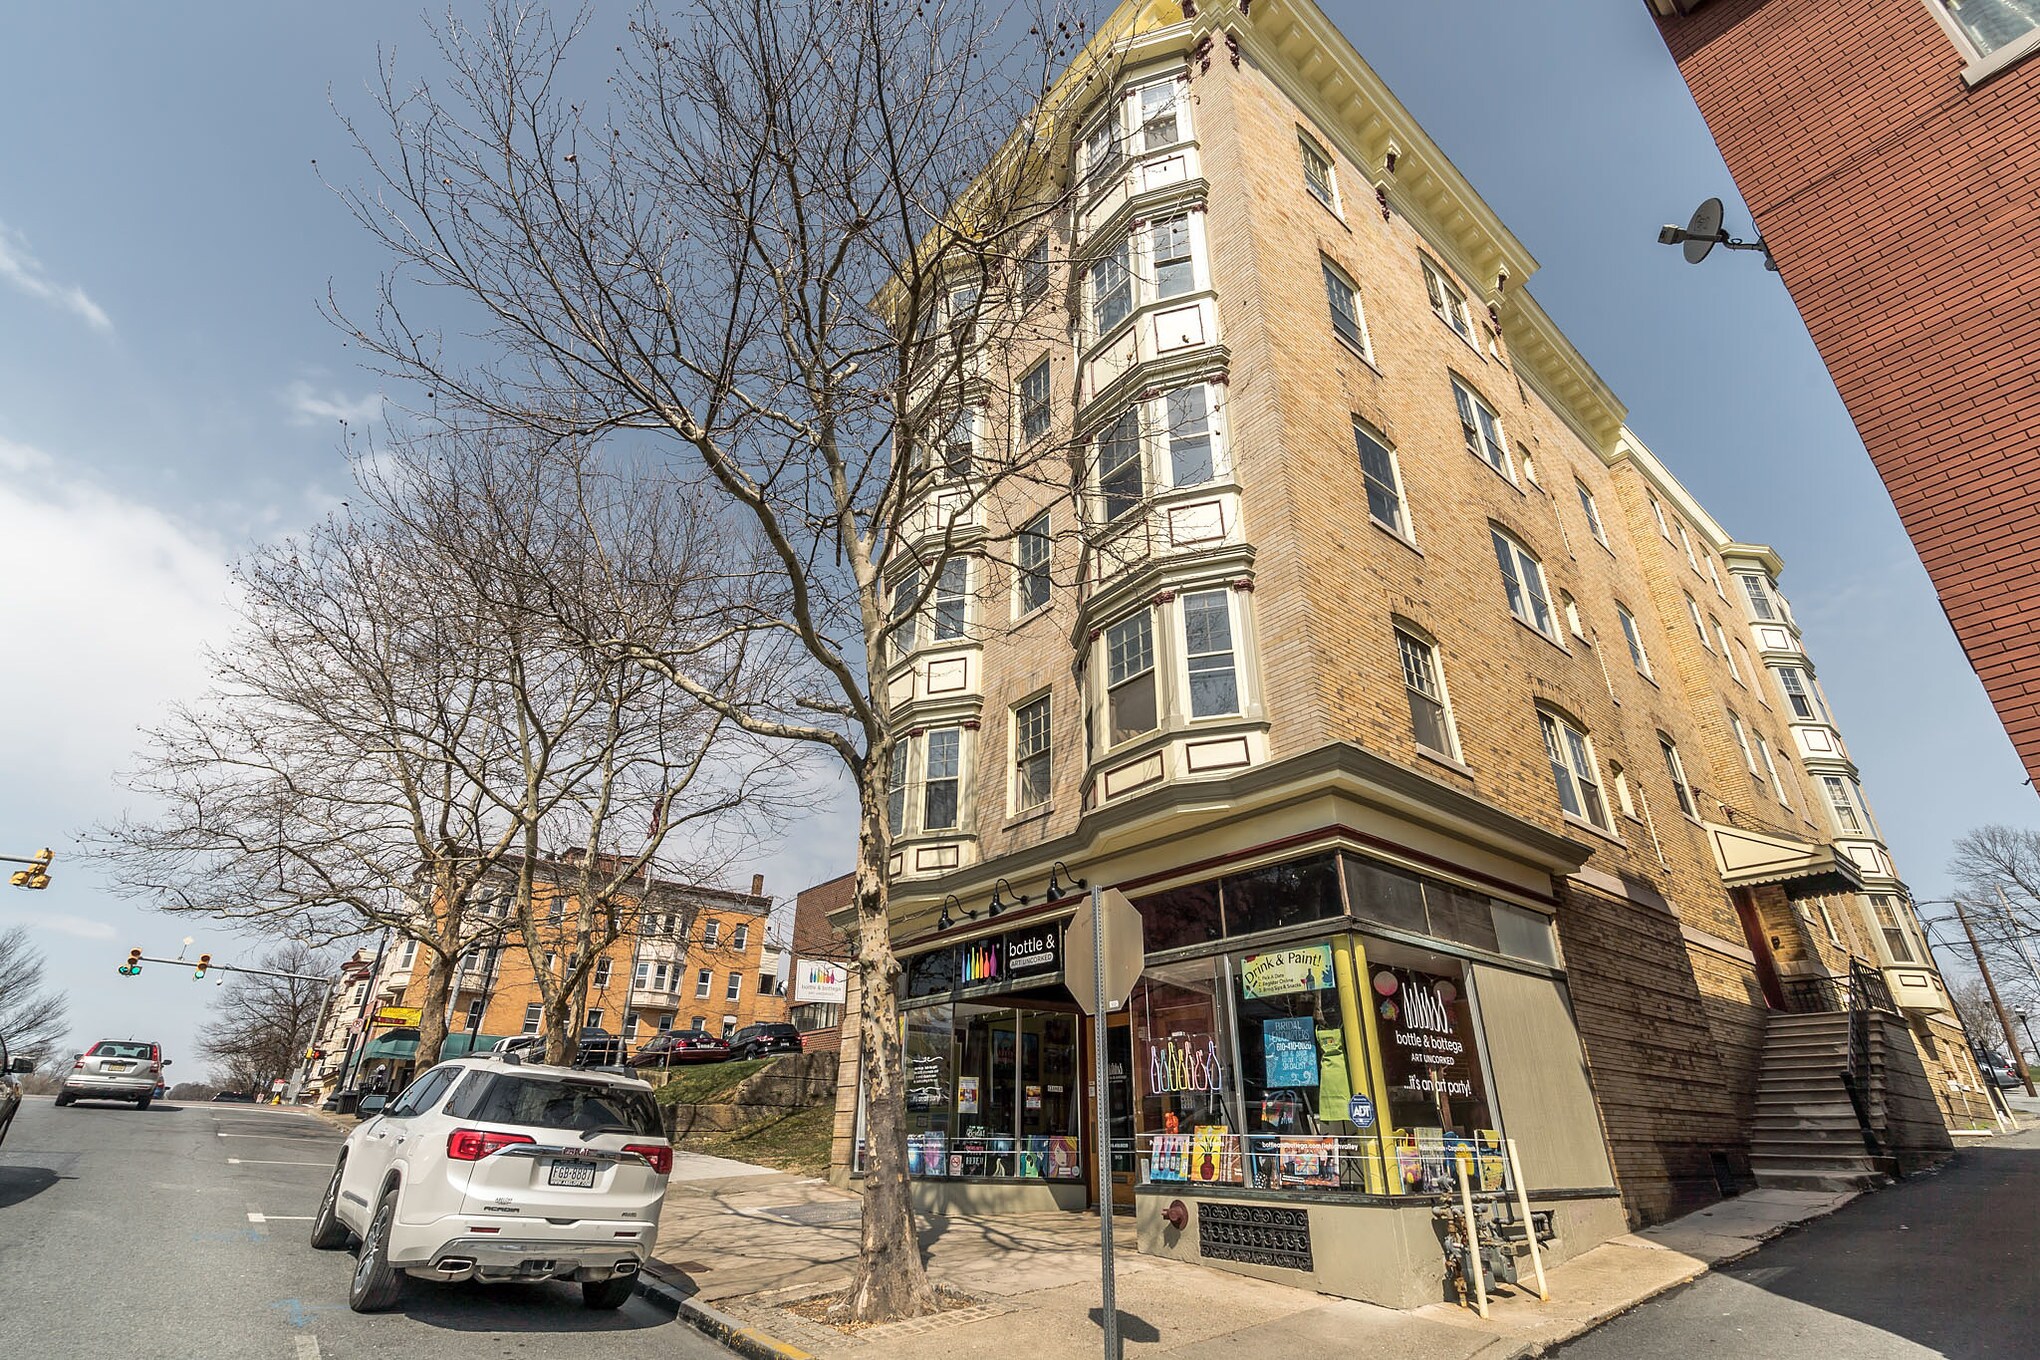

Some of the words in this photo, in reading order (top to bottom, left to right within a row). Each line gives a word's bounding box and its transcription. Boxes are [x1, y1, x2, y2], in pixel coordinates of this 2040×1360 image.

[1010, 937, 1043, 957] bottle
[1046, 934, 1055, 949] &
[1022, 954, 1052, 965] UNCORKED
[1244, 956, 1274, 984] Drink
[1275, 953, 1284, 966] &
[1288, 950, 1322, 967] Paint!
[1275, 1020, 1301, 1030] BRIDAL
[1395, 1030, 1422, 1047] bottle
[1423, 1034, 1430, 1048] &
[1430, 1034, 1463, 1054] bottega
[1411, 1053, 1422, 1062] ART
[1423, 1054, 1455, 1066] UNCORKED
[1422, 1079, 1434, 1091] an
[1435, 1078, 1447, 1093] art
[1447, 1079, 1472, 1097] party!
[1353, 1105, 1370, 1118] ADT
